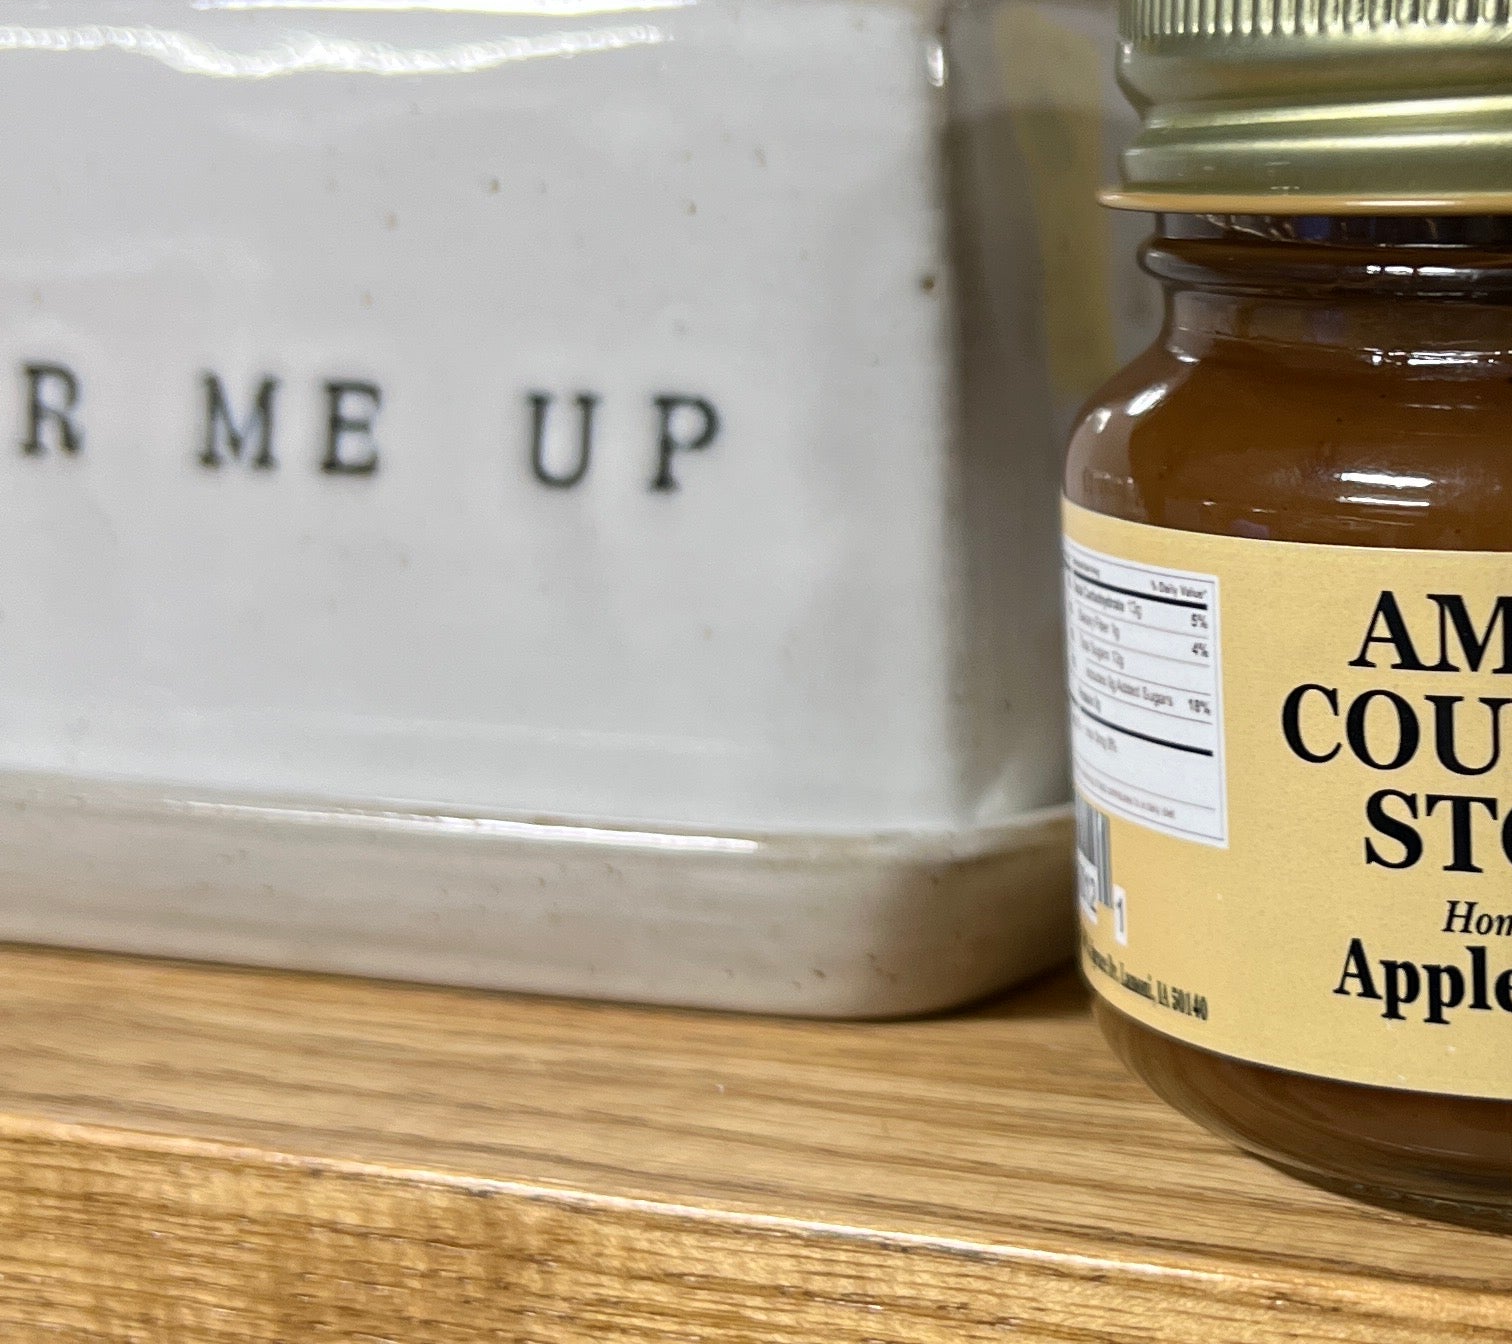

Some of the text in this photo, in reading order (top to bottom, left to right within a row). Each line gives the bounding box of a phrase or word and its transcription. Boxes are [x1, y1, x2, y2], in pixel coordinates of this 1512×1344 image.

[20, 360, 722, 493] R ME UP
